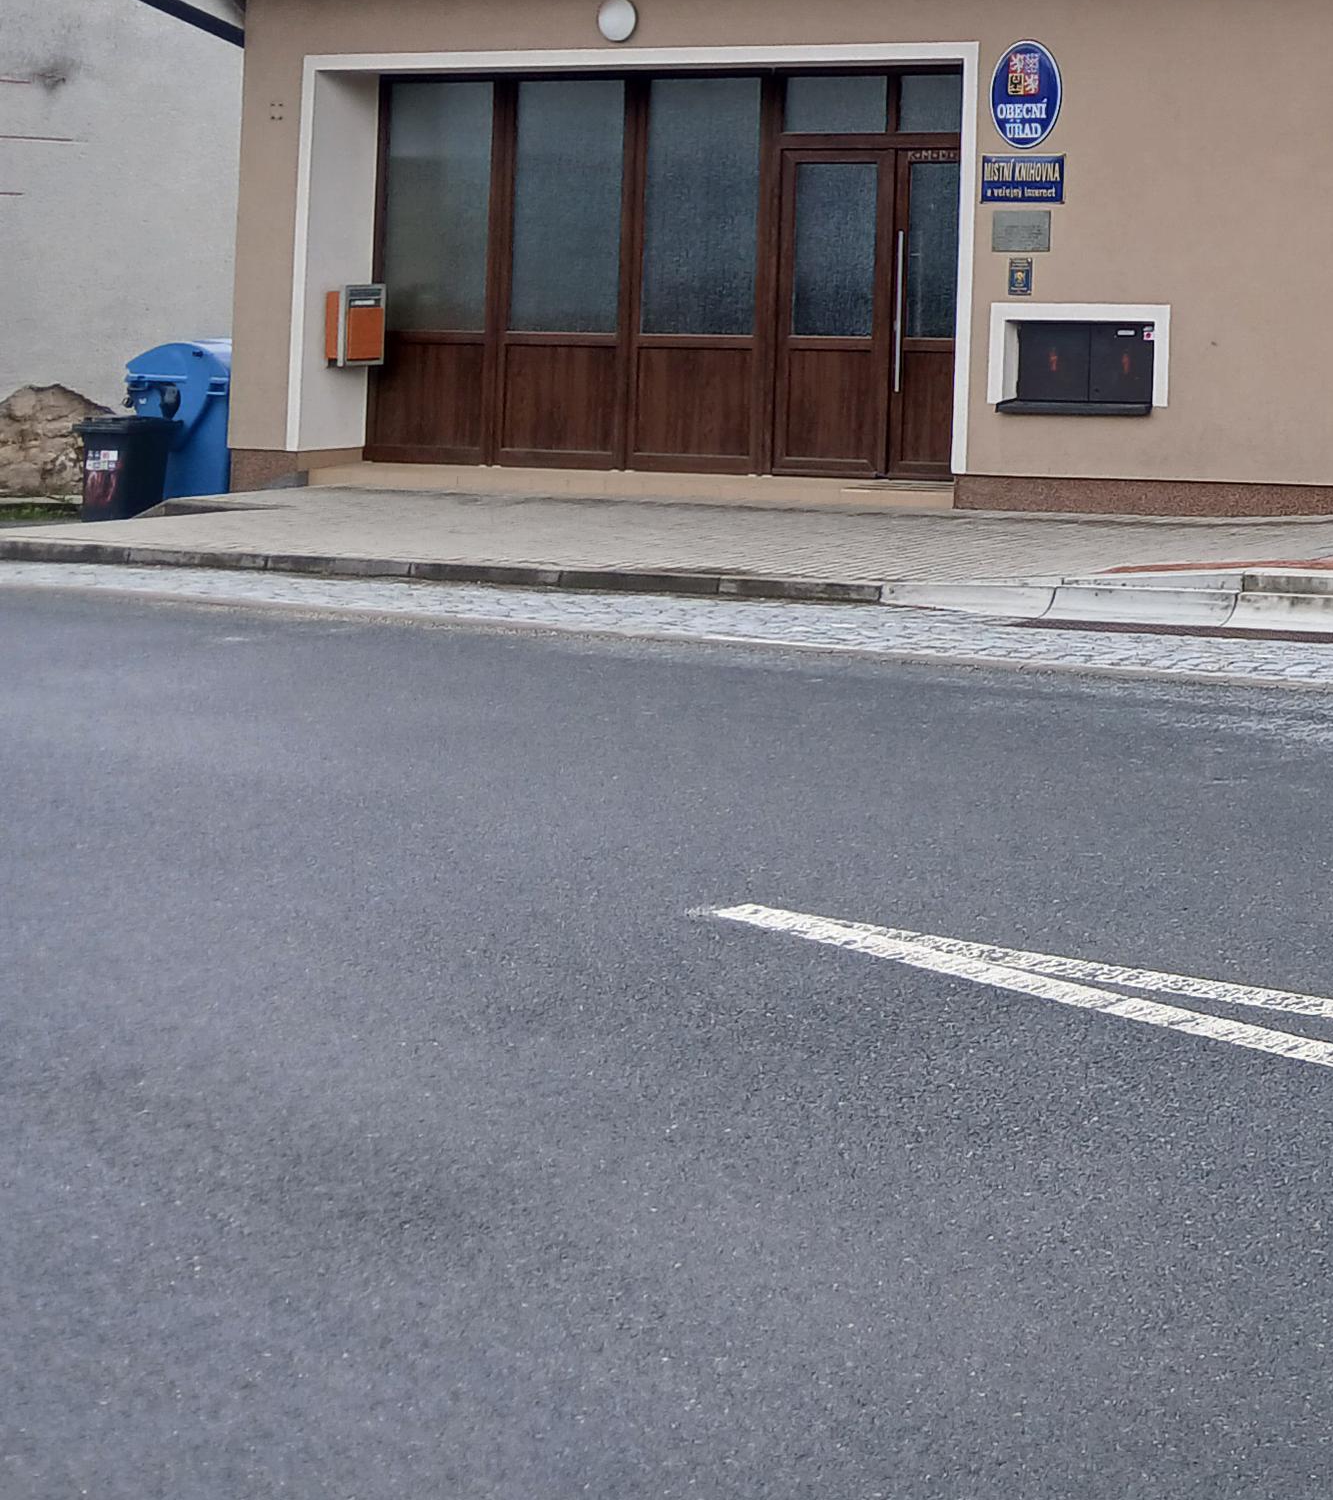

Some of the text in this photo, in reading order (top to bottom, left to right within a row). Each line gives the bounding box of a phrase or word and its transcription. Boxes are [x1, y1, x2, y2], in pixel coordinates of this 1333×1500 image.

[996, 98, 1048, 119] OBECNÍ
[1005, 118, 1042, 138] ÚŘAD
[984, 157, 1060, 182] MÍSTNÍ KNIHOVNA
